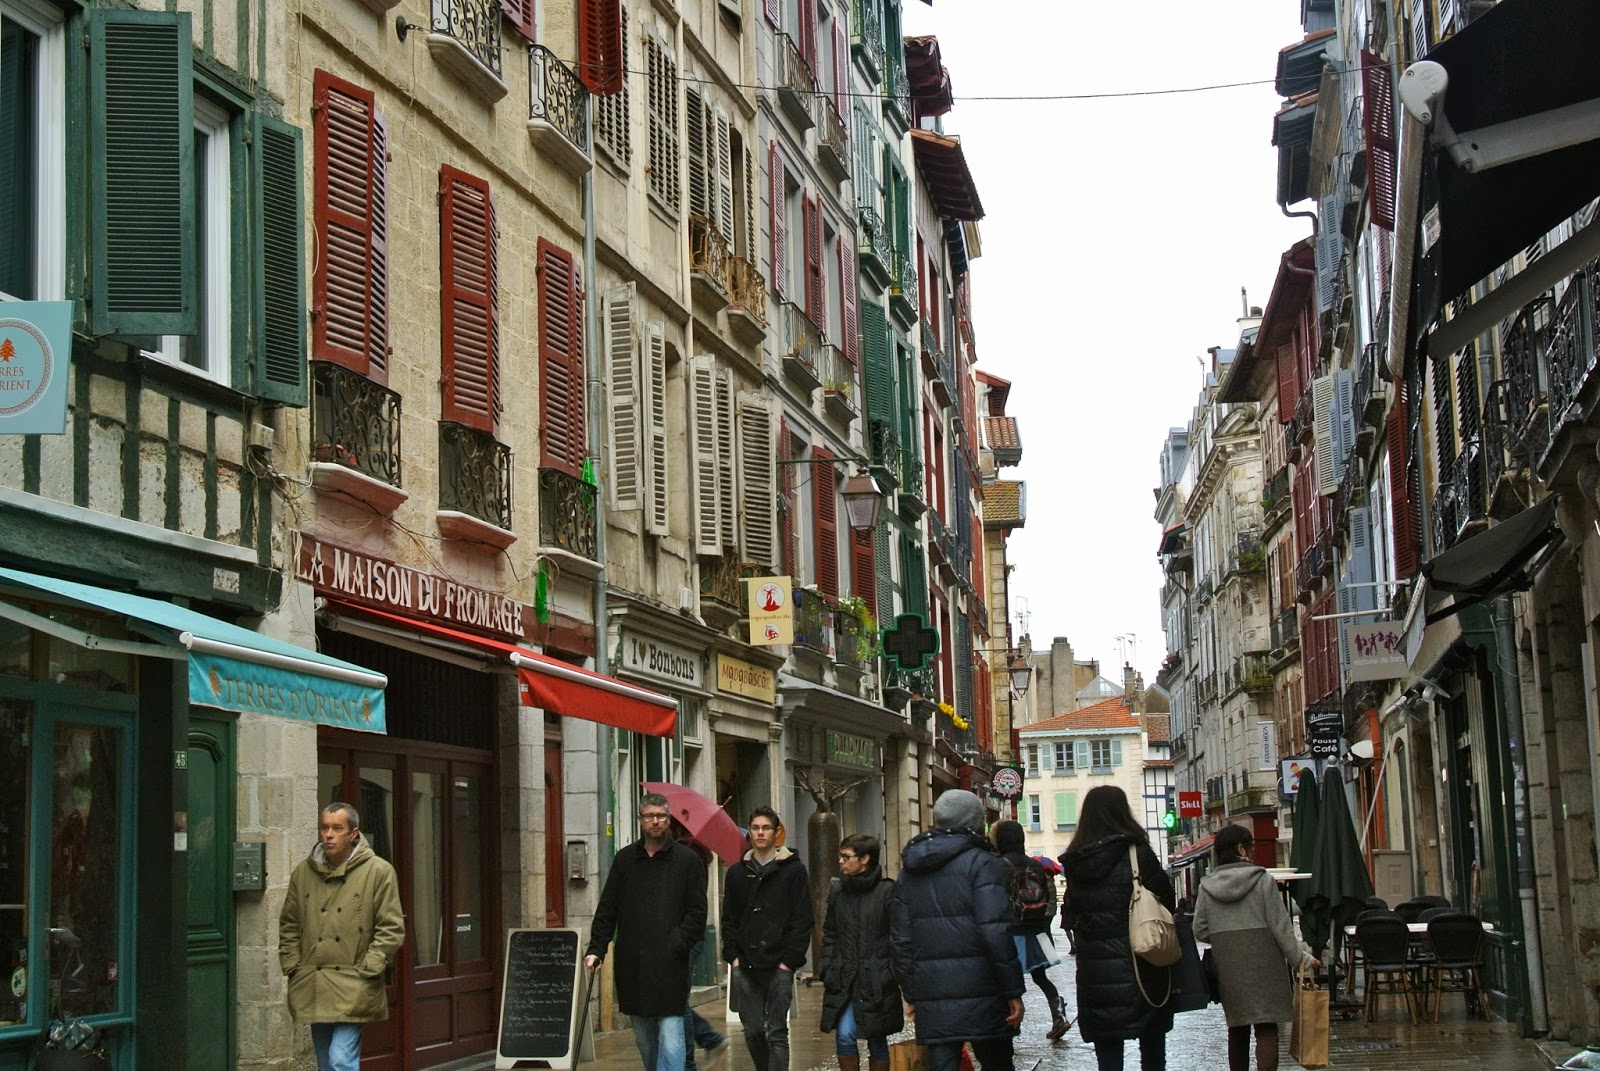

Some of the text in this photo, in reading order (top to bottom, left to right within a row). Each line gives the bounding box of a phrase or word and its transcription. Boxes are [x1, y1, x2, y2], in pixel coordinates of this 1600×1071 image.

[297, 538, 324, 586] LA
[332, 547, 412, 609] MAISON
[418, 572, 441, 616] DU
[444, 582, 525, 637] FROMAGE
[631, 638, 638, 665] I
[223, 679, 285, 712] TERRES
[176, 753, 187, 767] 45
[1313, 744, 1339, 753] Café
